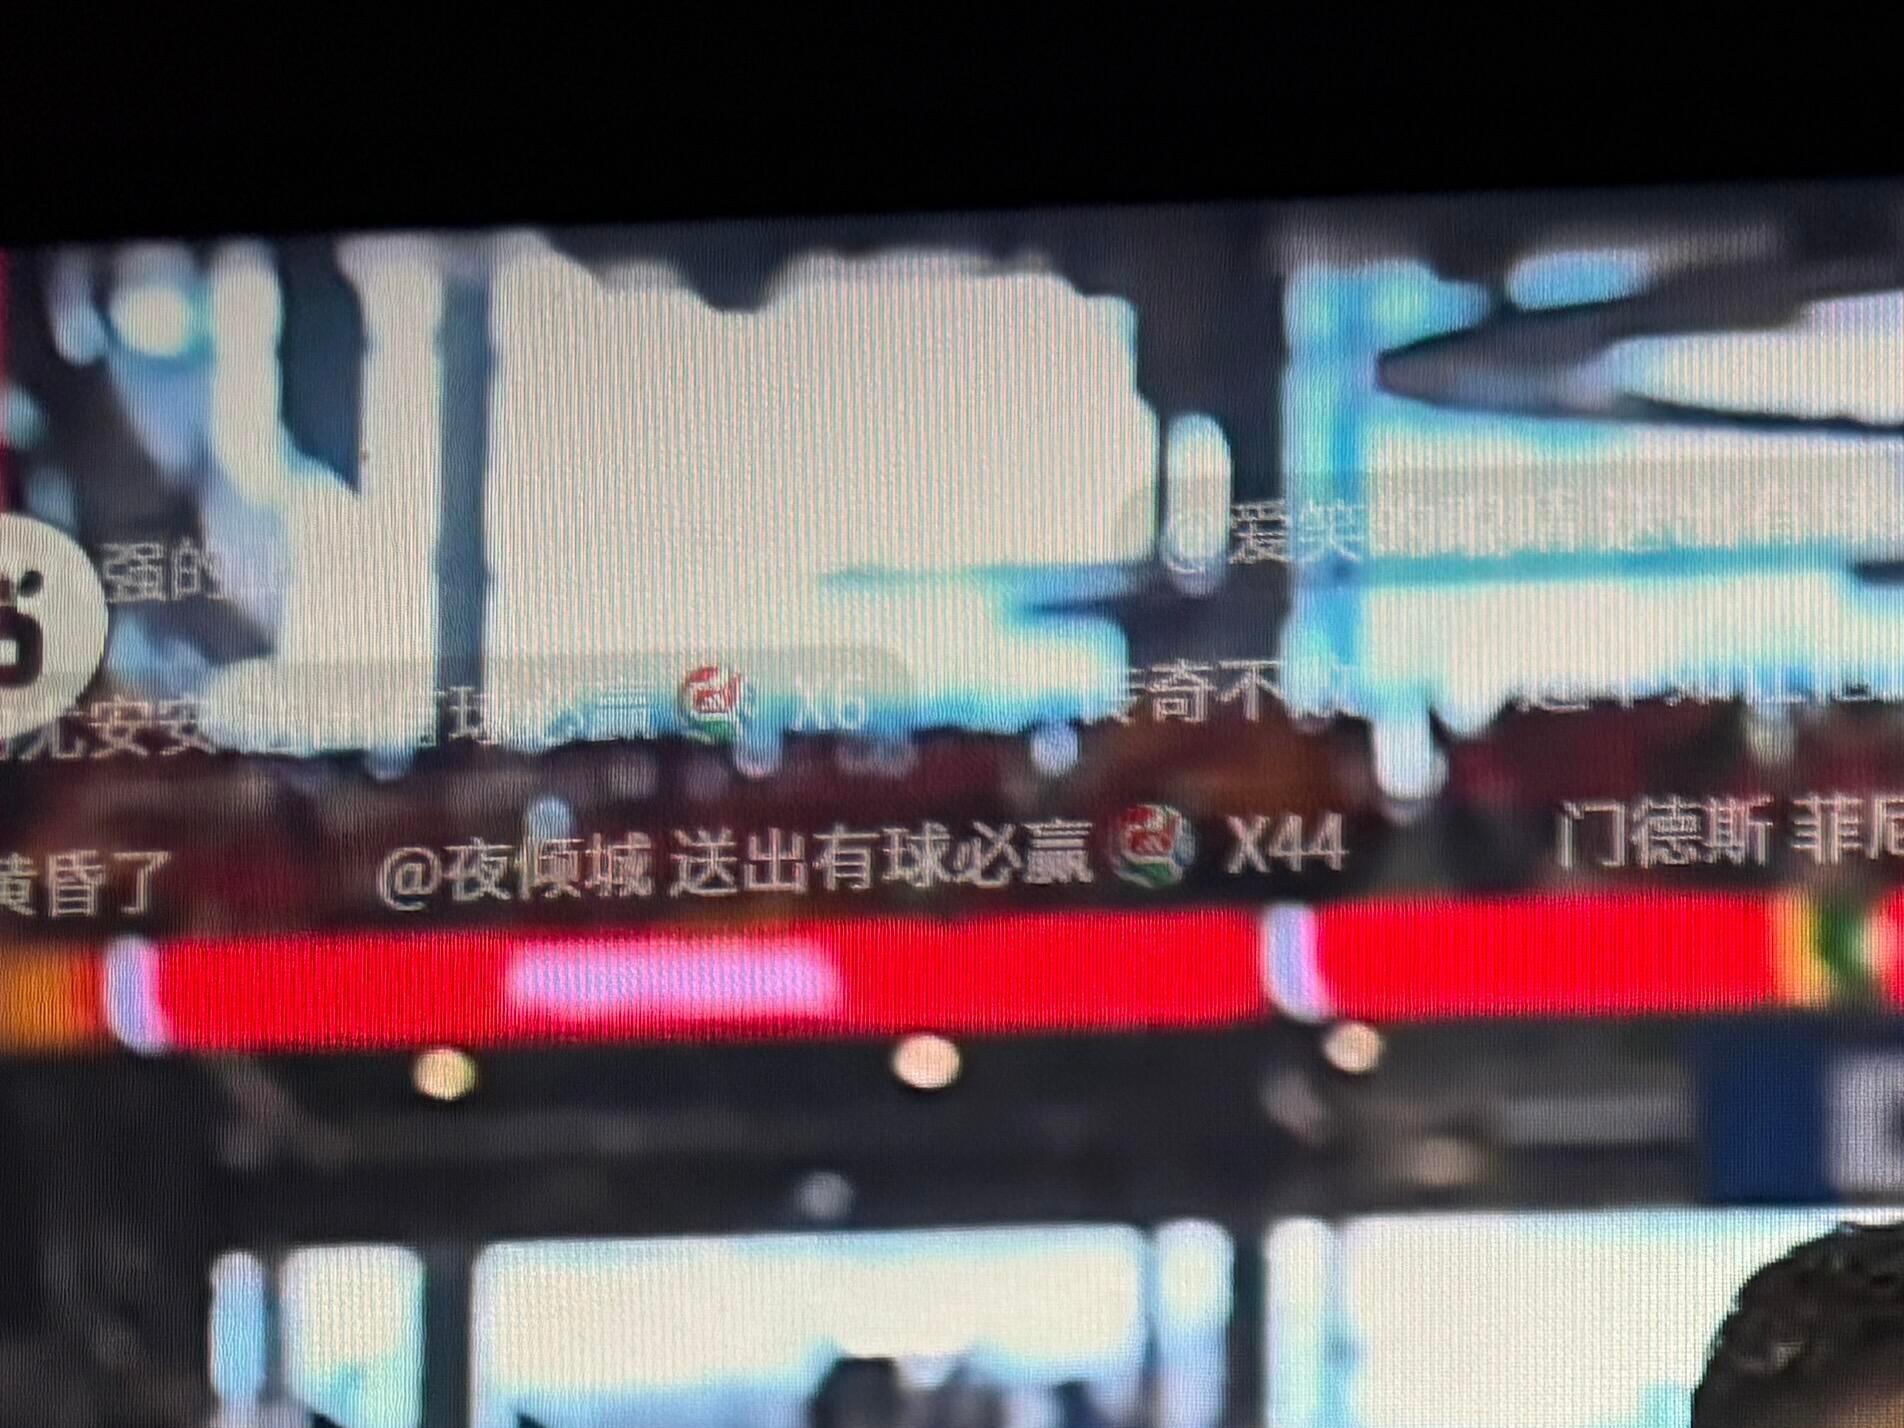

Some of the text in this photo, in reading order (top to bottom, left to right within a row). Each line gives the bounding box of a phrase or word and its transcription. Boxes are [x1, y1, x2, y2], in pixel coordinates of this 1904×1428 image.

[377, 815, 1350, 912] @夜倾城 送出有球必赢 X44
[1560, 797, 1771, 868] 门德斯
